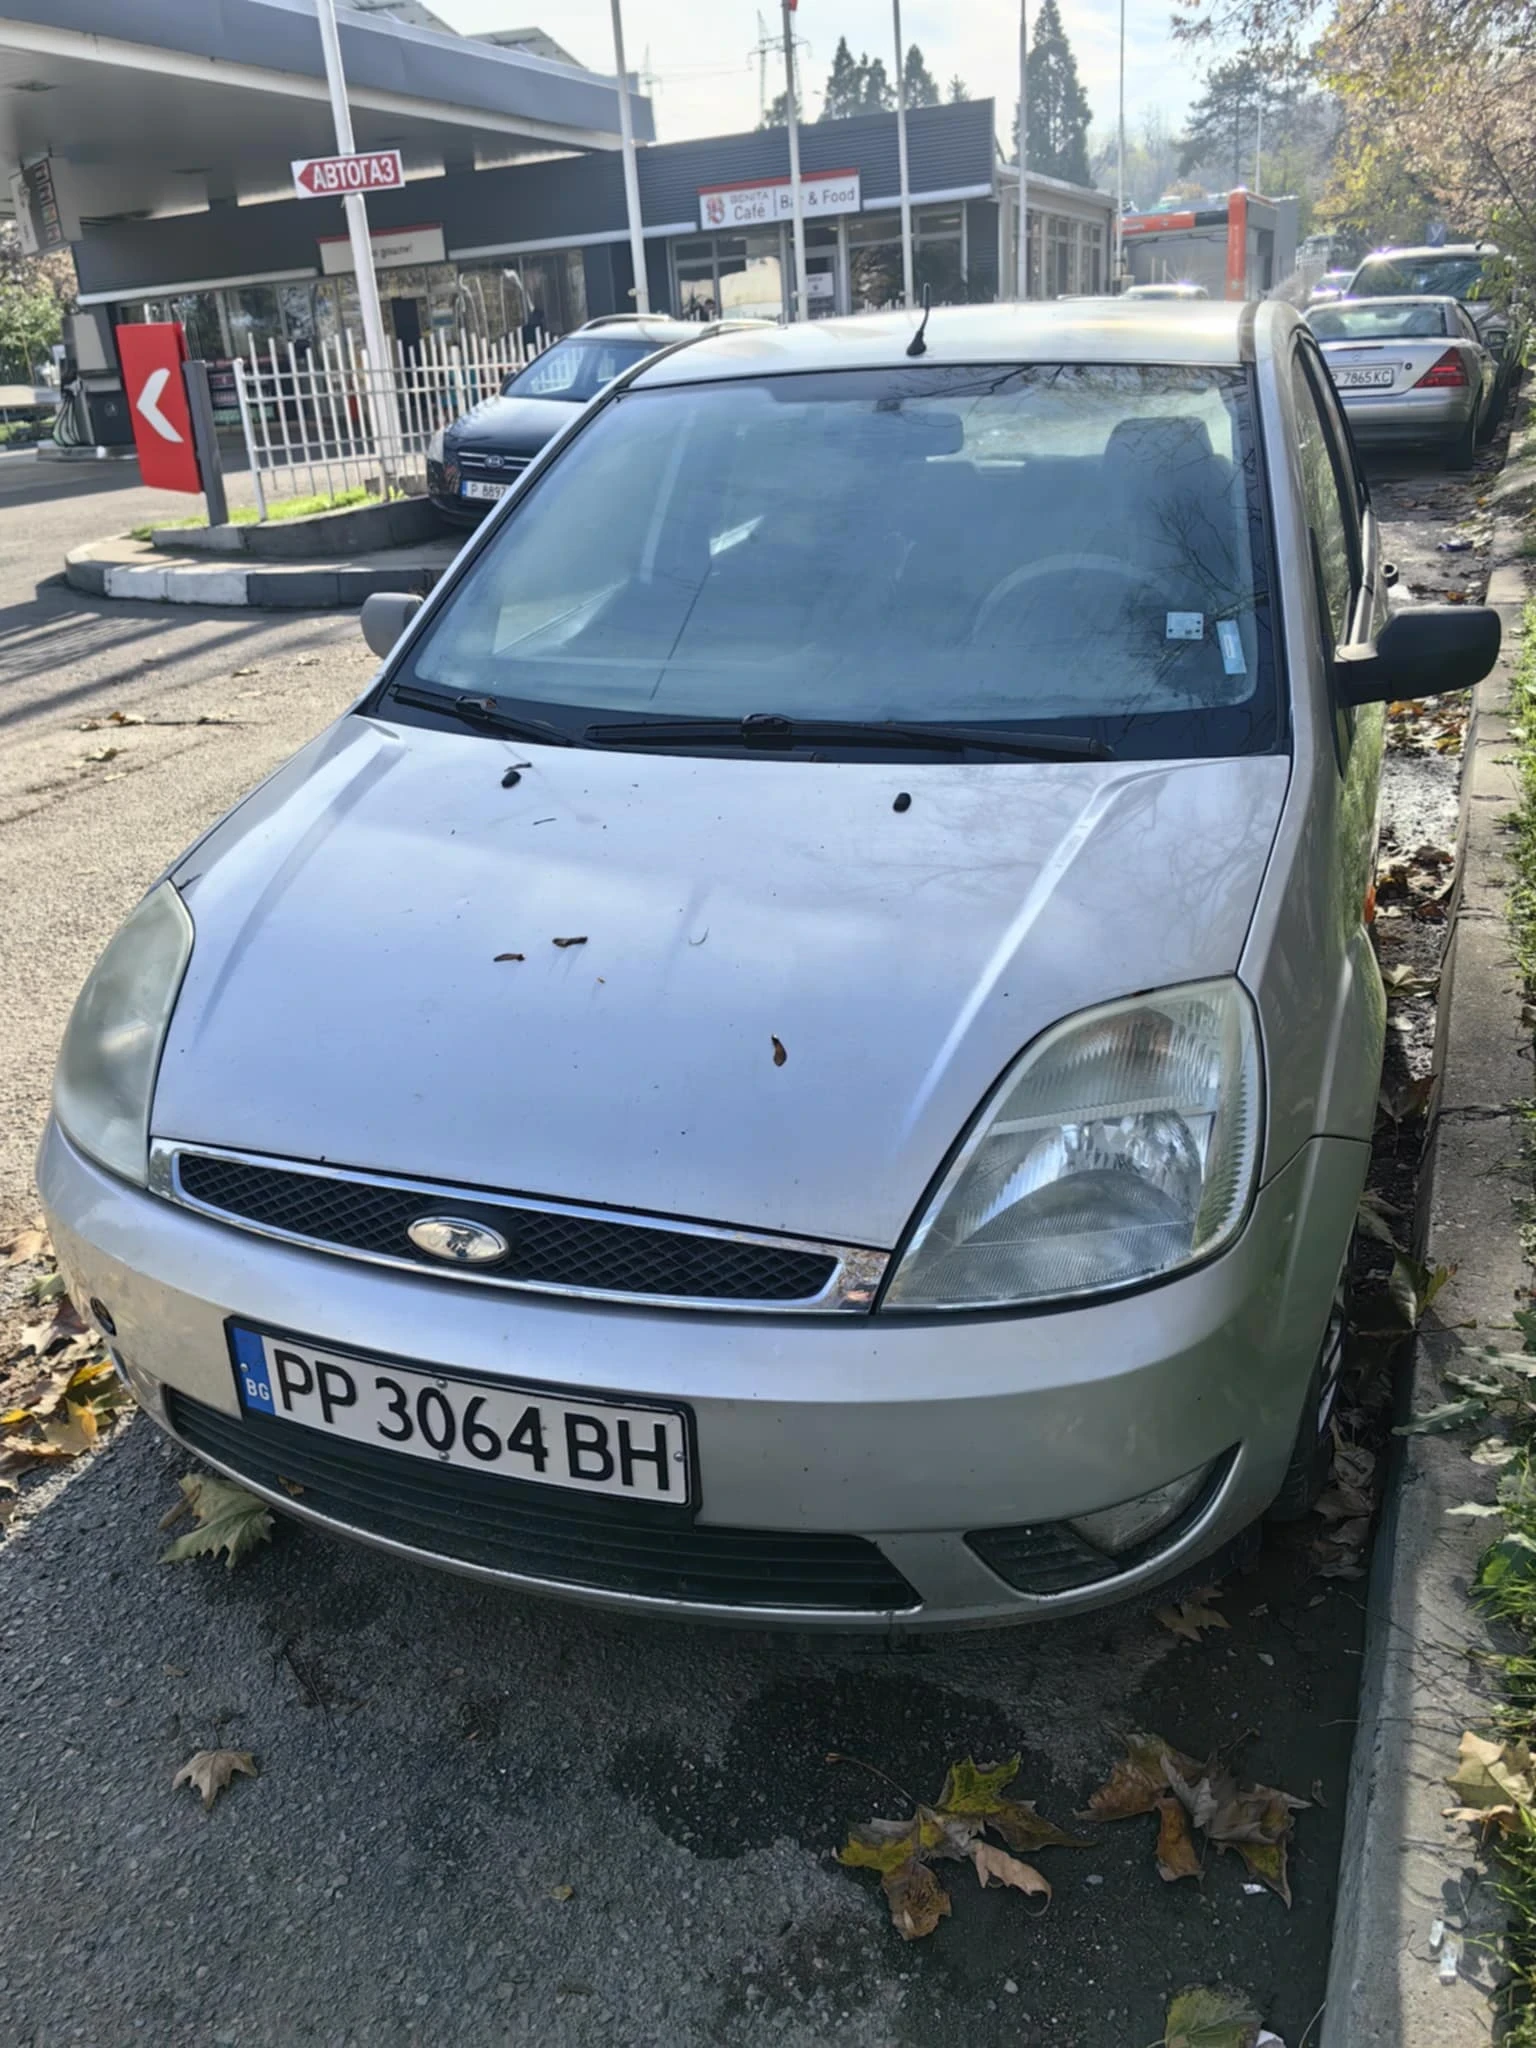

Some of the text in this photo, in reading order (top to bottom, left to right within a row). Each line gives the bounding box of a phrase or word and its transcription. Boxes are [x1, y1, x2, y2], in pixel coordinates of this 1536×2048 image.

[313, 157, 394, 190] АВТОГАЗ
[808, 191, 818, 206] &
[822, 187, 855, 204] Food
[734, 201, 766, 220] Café
[1343, 372, 1371, 385] 7865
[1374, 370, 1390, 382] KC
[245, 1378, 270, 1401] BG
[274, 1348, 671, 1491] PP 3064 BH
